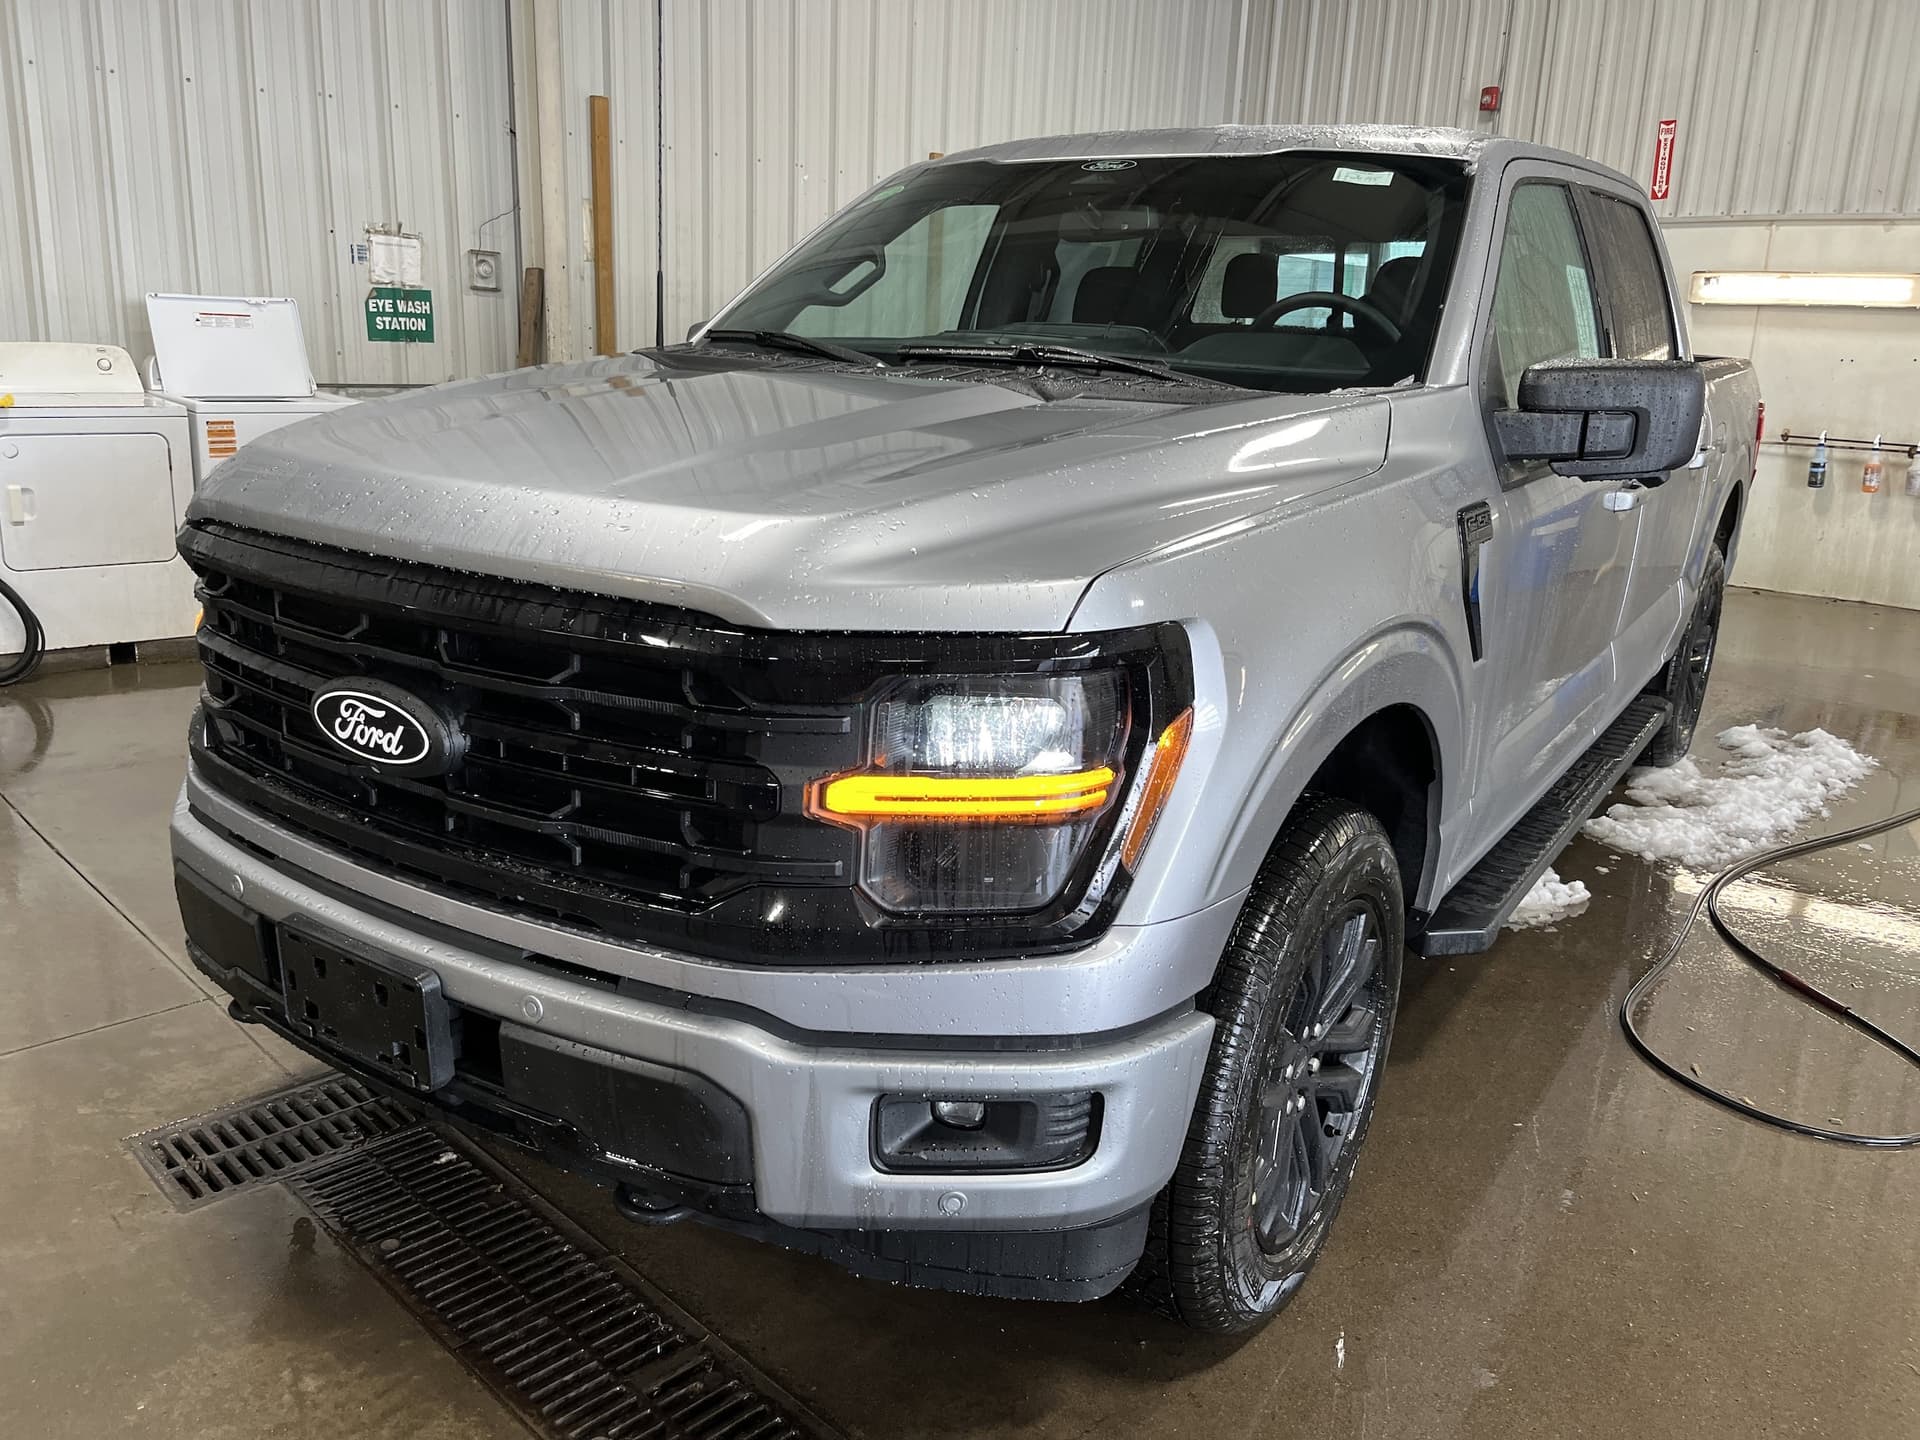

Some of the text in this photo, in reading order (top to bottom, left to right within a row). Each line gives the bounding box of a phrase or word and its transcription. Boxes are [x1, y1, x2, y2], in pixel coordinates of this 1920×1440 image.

[1657, 138, 1668, 194] EXTINGUISHER
[368, 298, 430, 314] EYE WASH
[375, 316, 426, 331] STATION
[334, 699, 404, 755] Ford
